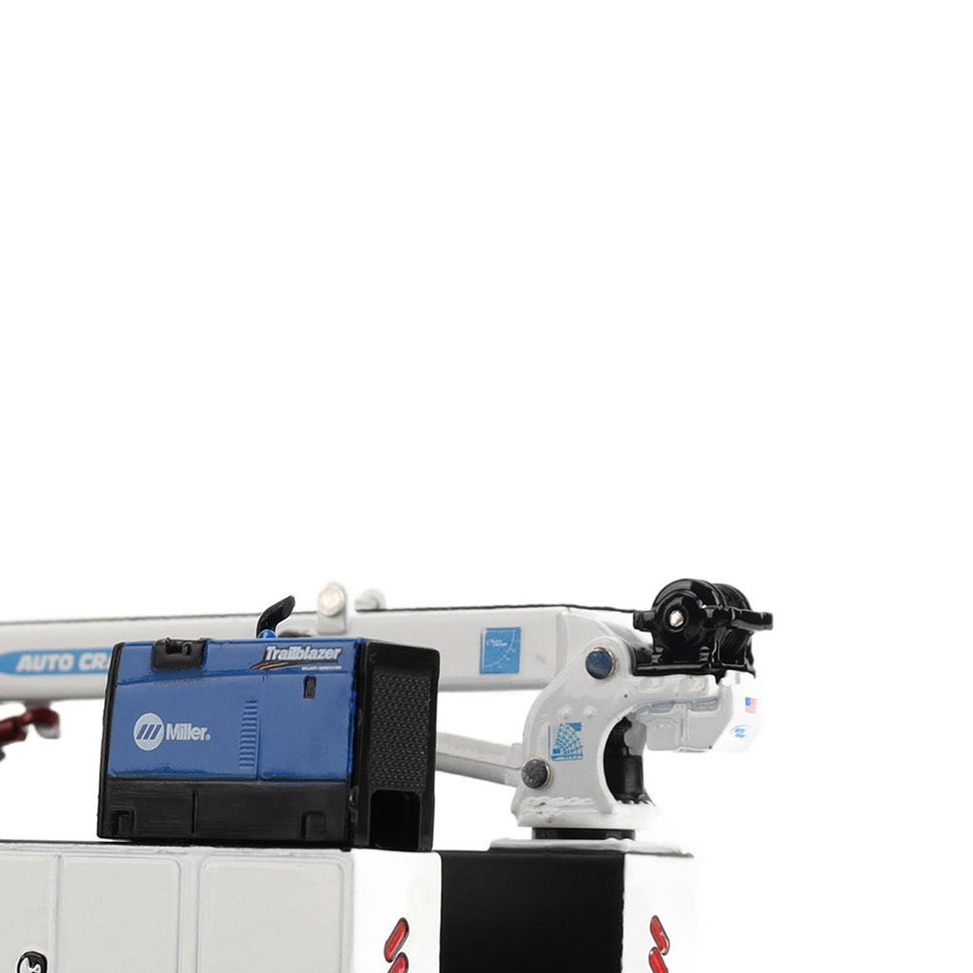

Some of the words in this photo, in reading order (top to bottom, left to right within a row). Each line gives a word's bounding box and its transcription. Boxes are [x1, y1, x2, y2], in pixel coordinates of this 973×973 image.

[16, 653, 74, 672] AUTO
[78, 652, 110, 671] CR
[266, 645, 342, 661] Trailblazer
